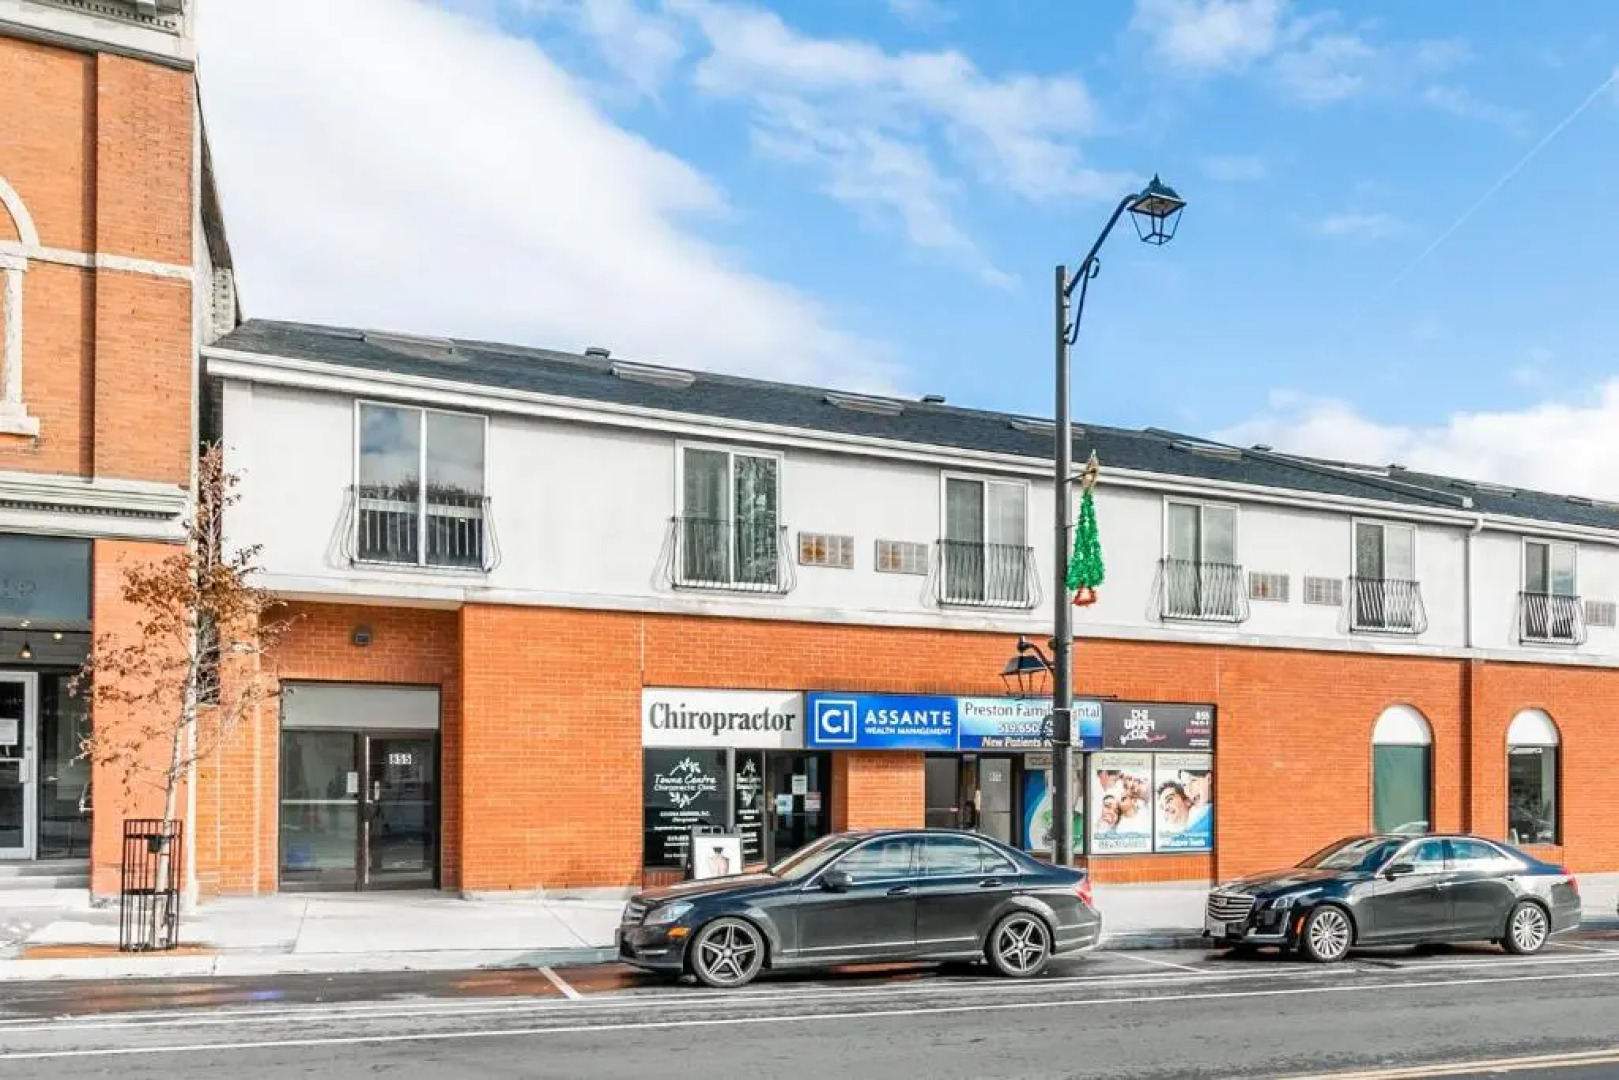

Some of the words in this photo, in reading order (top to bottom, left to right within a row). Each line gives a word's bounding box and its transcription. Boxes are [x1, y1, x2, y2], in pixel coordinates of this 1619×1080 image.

[965, 702, 1012, 716] Preston
[650, 702, 796, 735] Chiropractor
[821, 709, 850, 734] CI
[865, 709, 952, 725] ASSANTE
[865, 726, 895, 735] WEALTH
[897, 727, 952, 736] MANAGEMENT
[981, 736, 1003, 747] New
[1005, 737, 1041, 747] Patients
